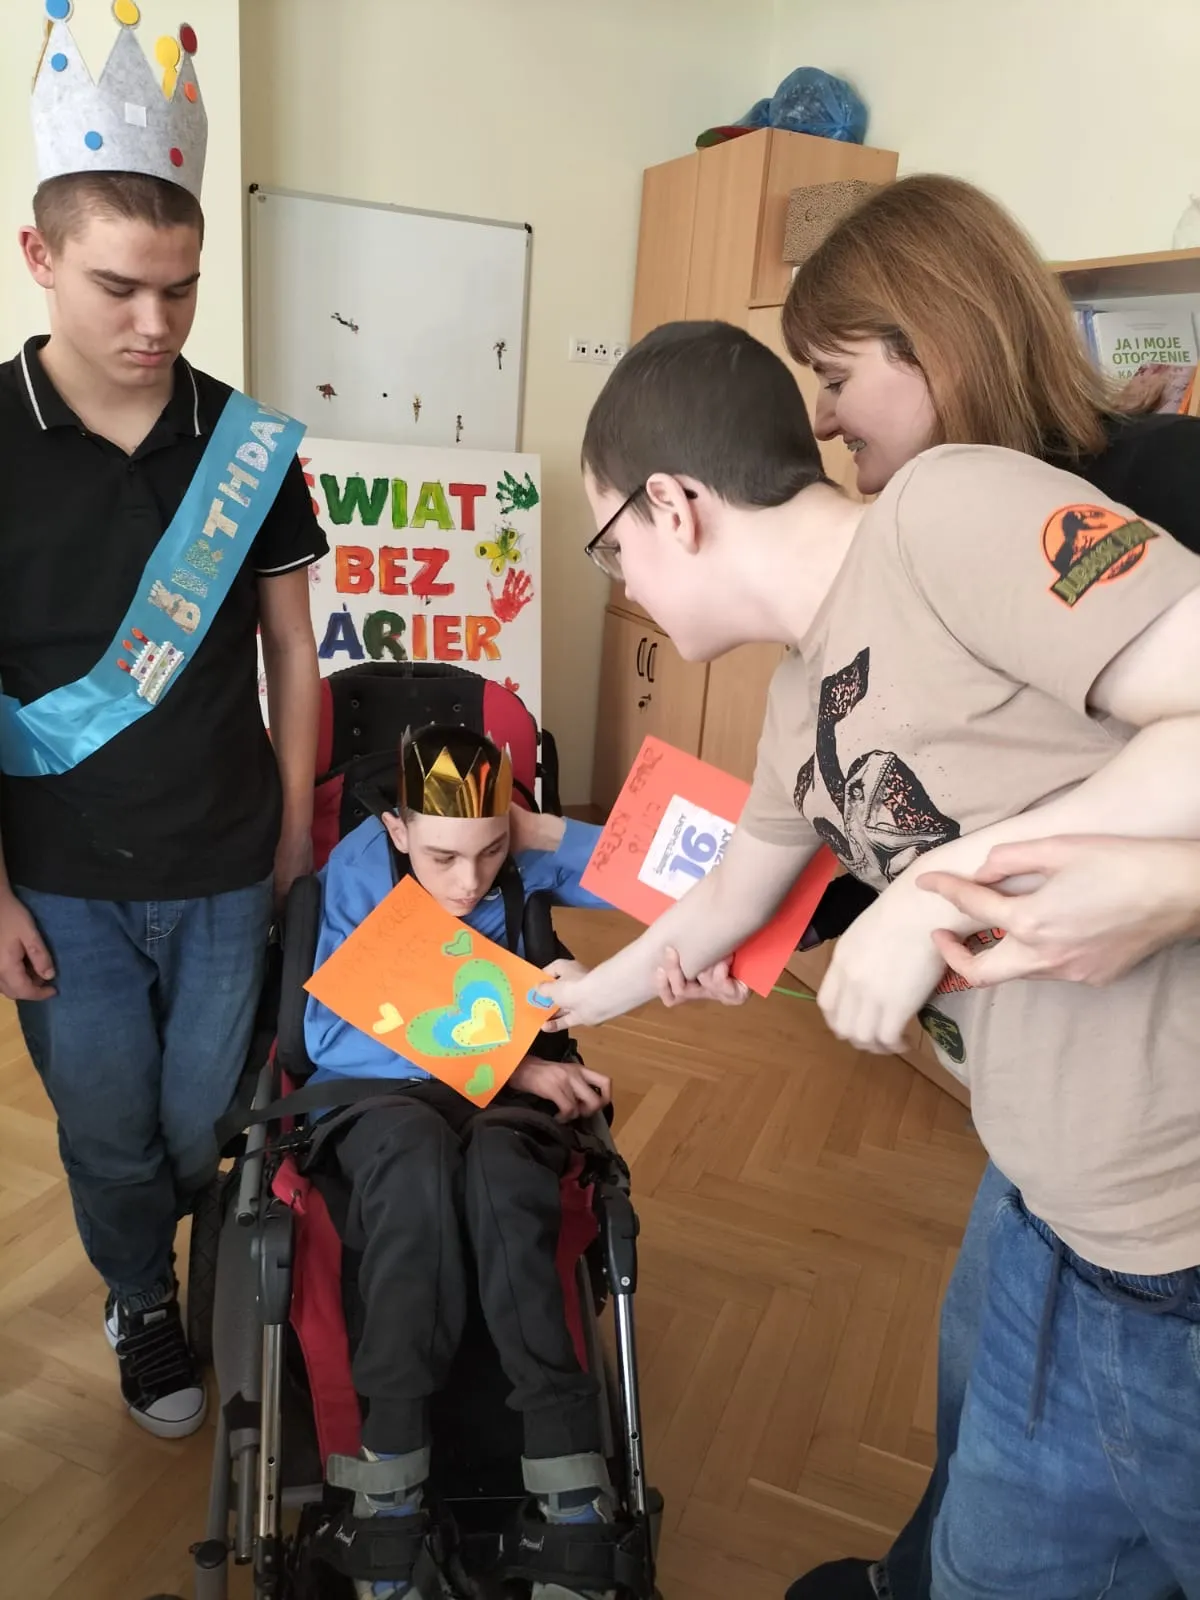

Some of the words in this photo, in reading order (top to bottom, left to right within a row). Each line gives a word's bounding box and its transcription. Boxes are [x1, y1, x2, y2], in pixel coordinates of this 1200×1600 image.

[1112, 351, 1191, 365] OTOCZENIE
[1115, 338, 1132, 350] JA
[1135, 337, 1140, 349] I
[1144, 337, 1181, 349] MOJE
[335, 545, 455, 596] BEZ
[318, 609, 502, 661] ARIER
[669, 825, 717, 880] 16
